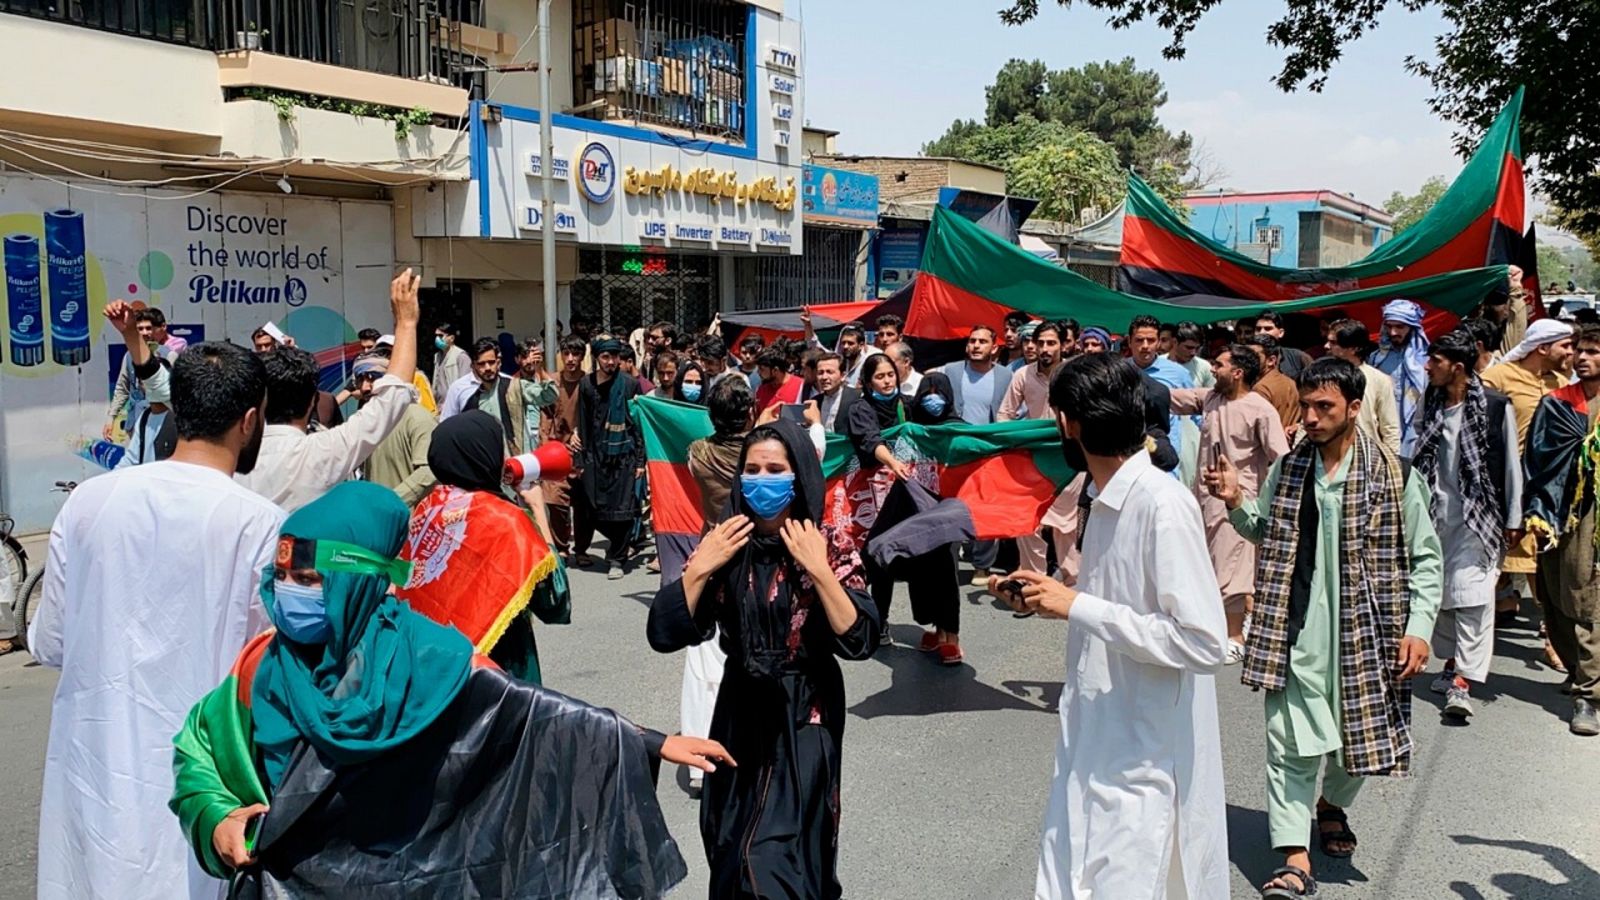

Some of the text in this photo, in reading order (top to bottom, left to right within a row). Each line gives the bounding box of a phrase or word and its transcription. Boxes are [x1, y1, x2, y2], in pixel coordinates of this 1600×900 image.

[771, 49, 796, 67] TTN
[774, 77, 794, 93] Solar
[779, 132, 790, 144] TV
[187, 206, 288, 236] Discover
[644, 222, 667, 237] UPS
[675, 224, 713, 240] Inverter
[721, 227, 752, 242] Battery
[187, 240, 328, 270] the world of
[189, 274, 281, 306] Pelikan
